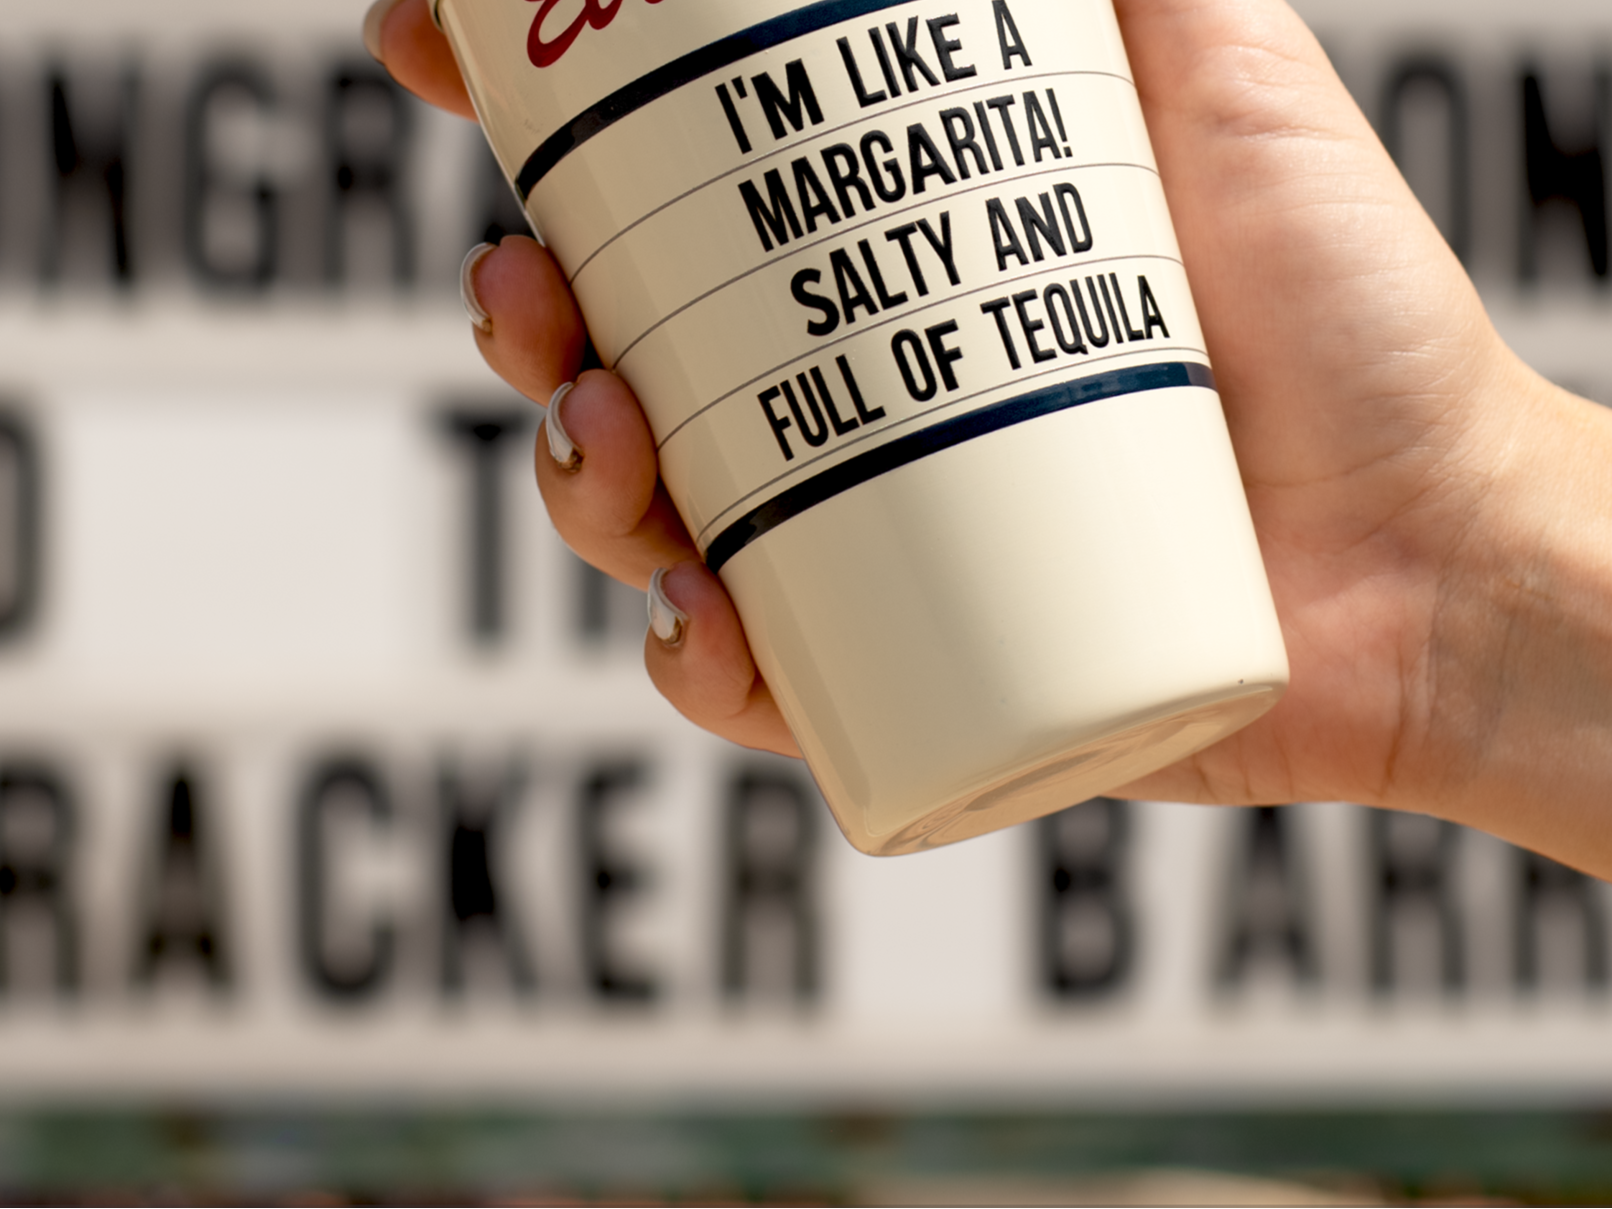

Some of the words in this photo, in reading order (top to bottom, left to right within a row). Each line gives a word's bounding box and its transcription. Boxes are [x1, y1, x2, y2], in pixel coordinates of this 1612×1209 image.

[715, 58, 824, 154] I'M
[836, 12, 977, 108] LIKE
[737, 88, 1073, 253] MARGARITA!
[790, 210, 961, 336] SALTY
[985, 182, 1093, 272] AND
[757, 353, 886, 461] FULL
[891, 318, 963, 402] OF
[980, 272, 1170, 370] TEQUILA
